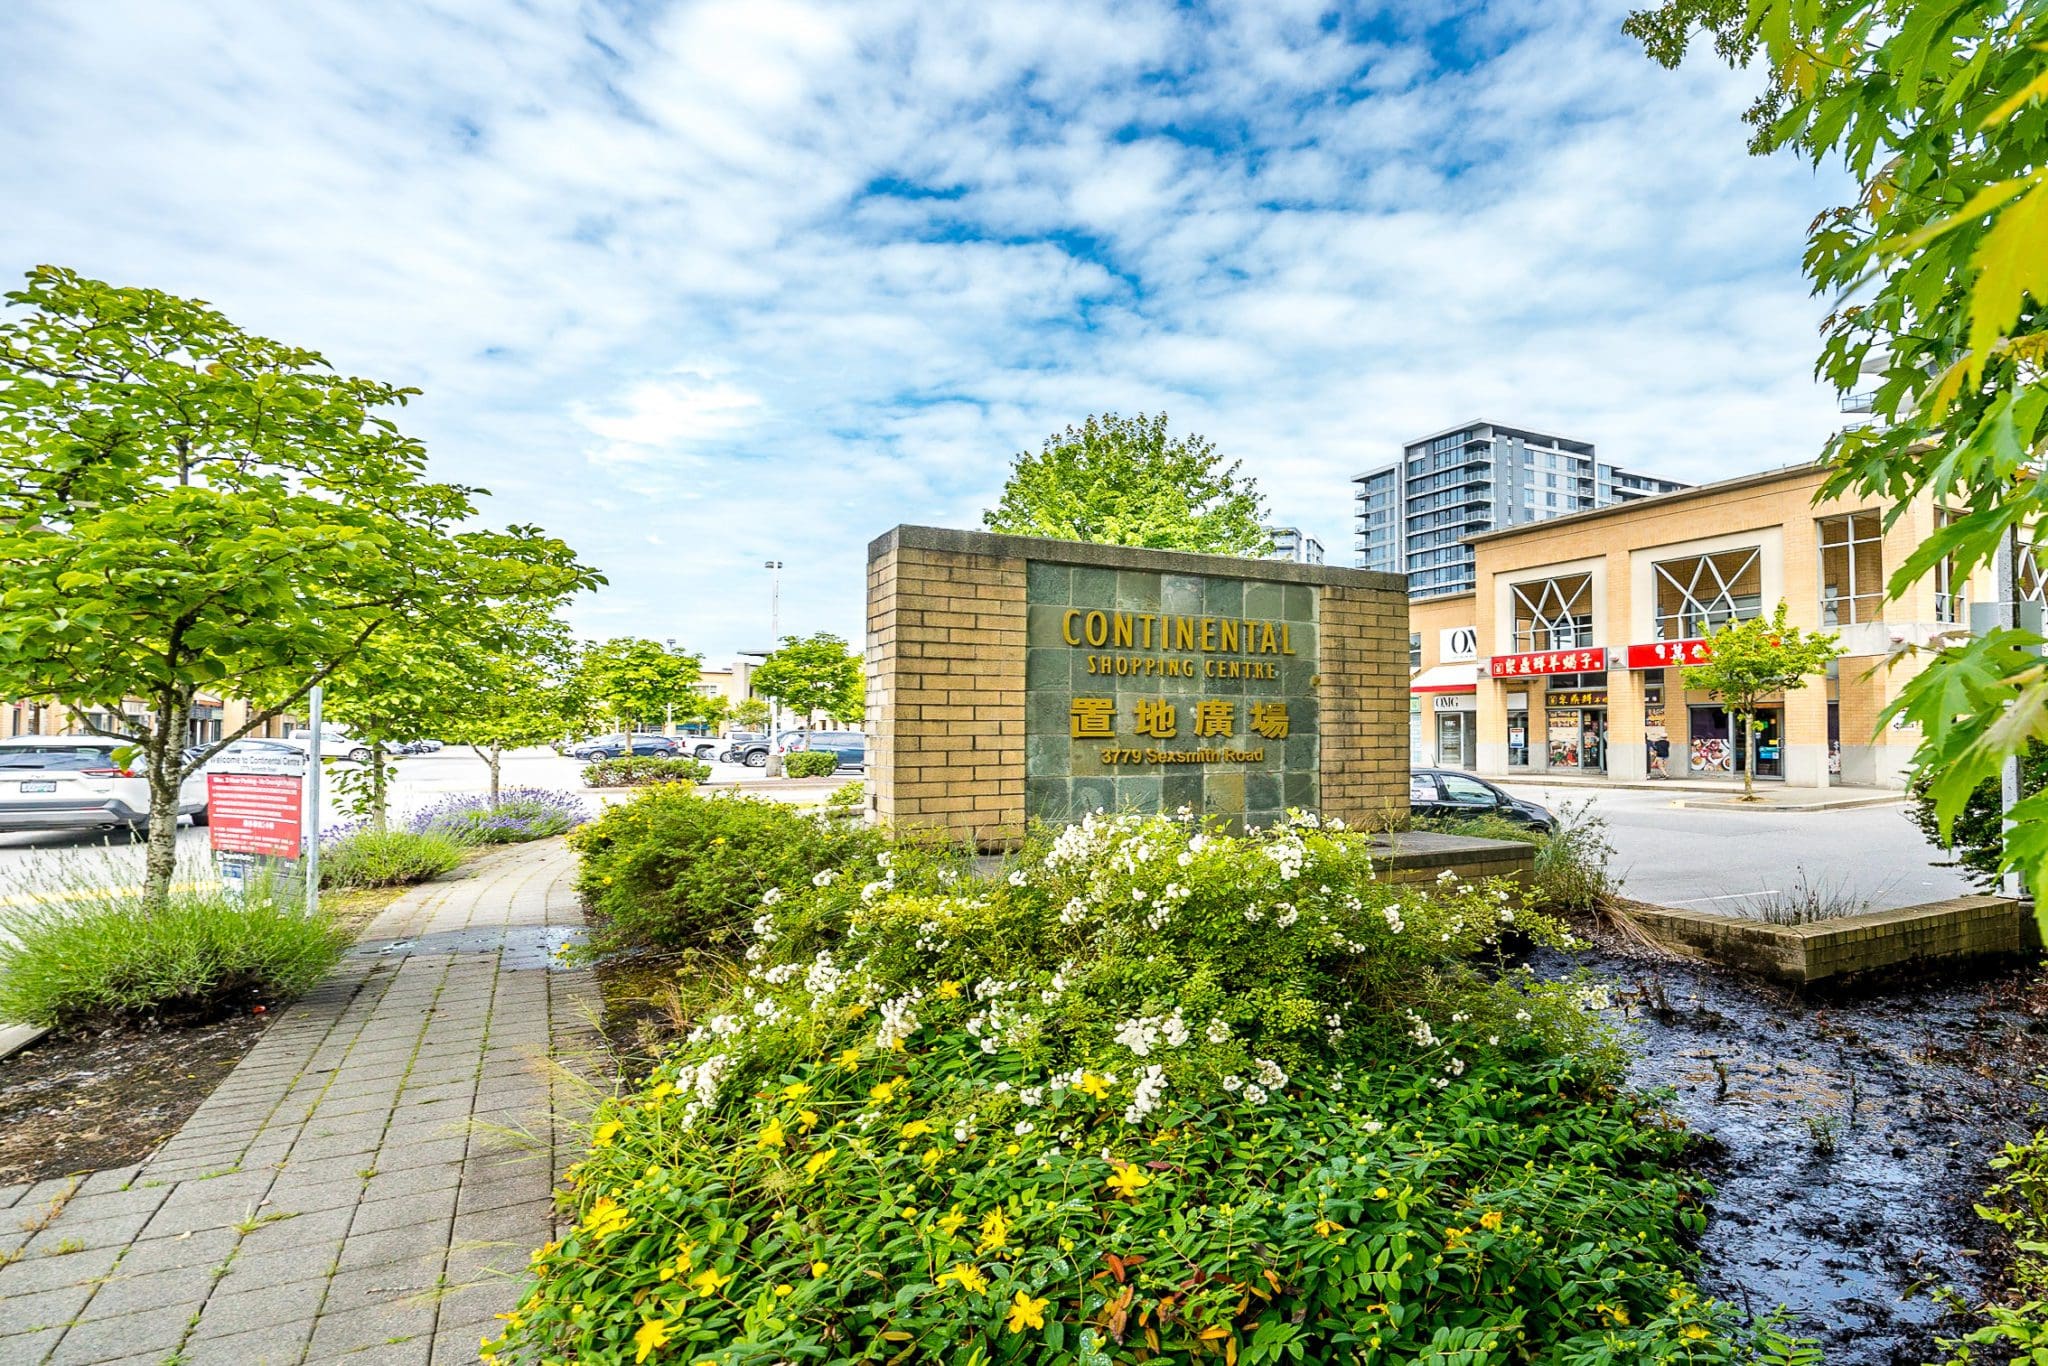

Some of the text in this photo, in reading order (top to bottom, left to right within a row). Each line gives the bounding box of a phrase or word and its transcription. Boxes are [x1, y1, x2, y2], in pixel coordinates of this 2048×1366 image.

[1062, 609, 1296, 655] CONTINENTAL
[1451, 629, 1477, 654] OM
[1087, 655, 1276, 680] SHOPPING CENTRE
[1435, 696, 1459, 708] OMG
[1069, 697, 1290, 740] 置地廣場
[210, 755, 240, 765] Welcome
[241, 757, 249, 765] to
[250, 755, 282, 766] Continental
[1101, 747, 1265, 765] 3779 Sexsmith Road
